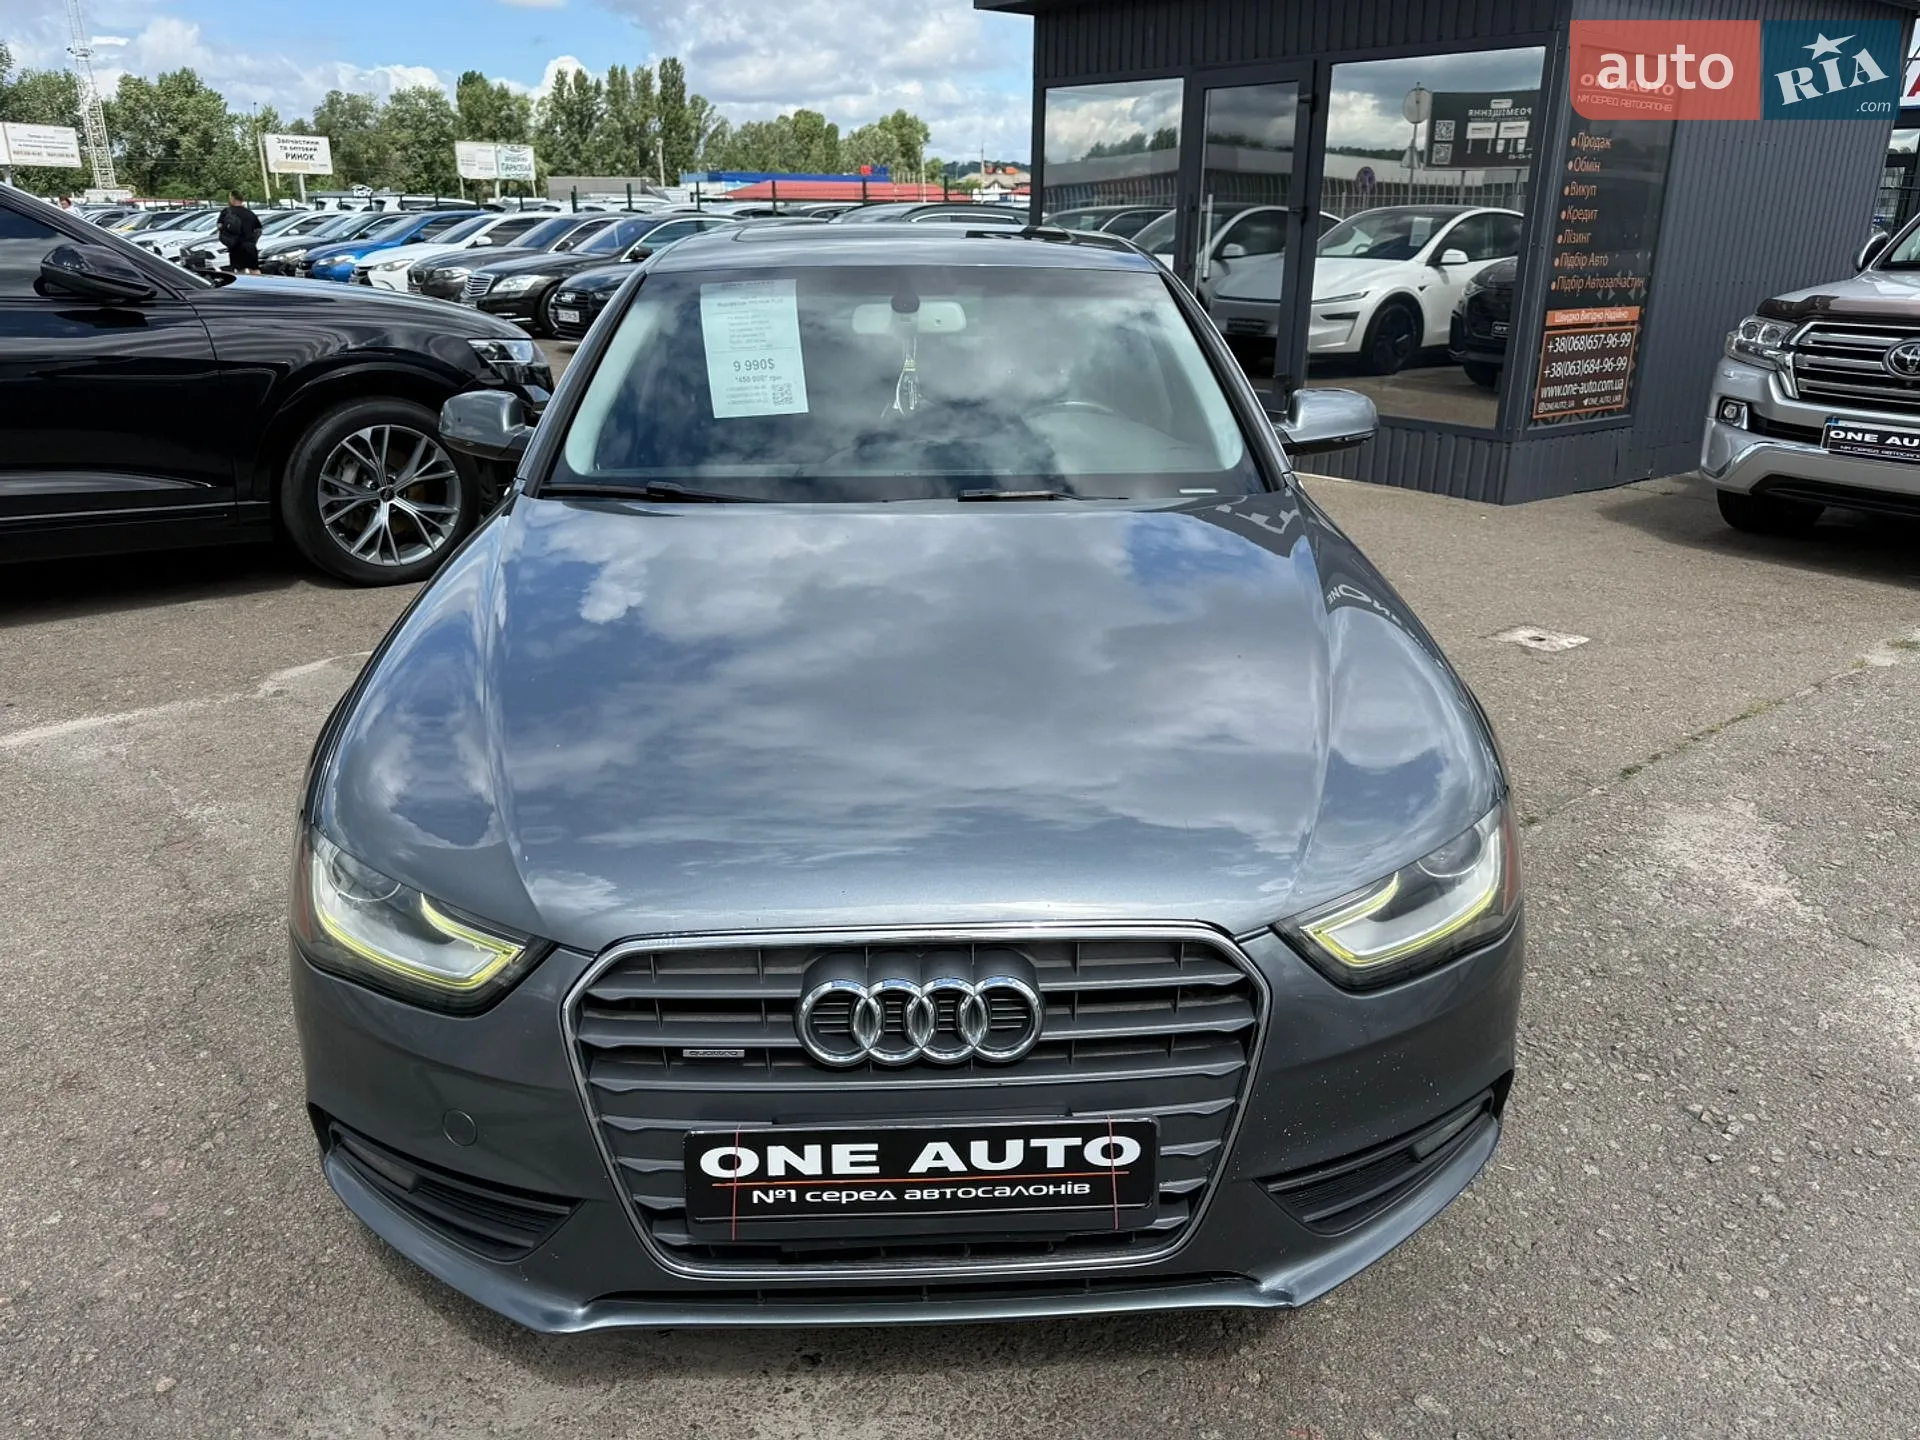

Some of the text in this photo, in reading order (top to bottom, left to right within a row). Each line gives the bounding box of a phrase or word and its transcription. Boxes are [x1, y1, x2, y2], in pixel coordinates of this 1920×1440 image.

[1576, 132, 1613, 151] Продаж
[285, 152, 316, 161] РИНОК
[1573, 156, 1602, 173] Обмін
[1570, 181, 1598, 200] Викуп
[1566, 205, 1599, 222] Кредит
[1562, 229, 1592, 244] Лізинг
[1559, 252, 1609, 270] Підбір Авто
[1547, 331, 1632, 355] +38(068)657-96-99
[733, 361, 741, 371] 9
[1543, 355, 1628, 380] +38(063)684-96-99
[1540, 378, 1625, 399] www.one-auto.com.ua
[1830, 430, 1879, 443] ONE
[699, 1135, 1142, 1178] ONE AUTO
[752, 1181, 1091, 1204] №1 серед автосалонів
